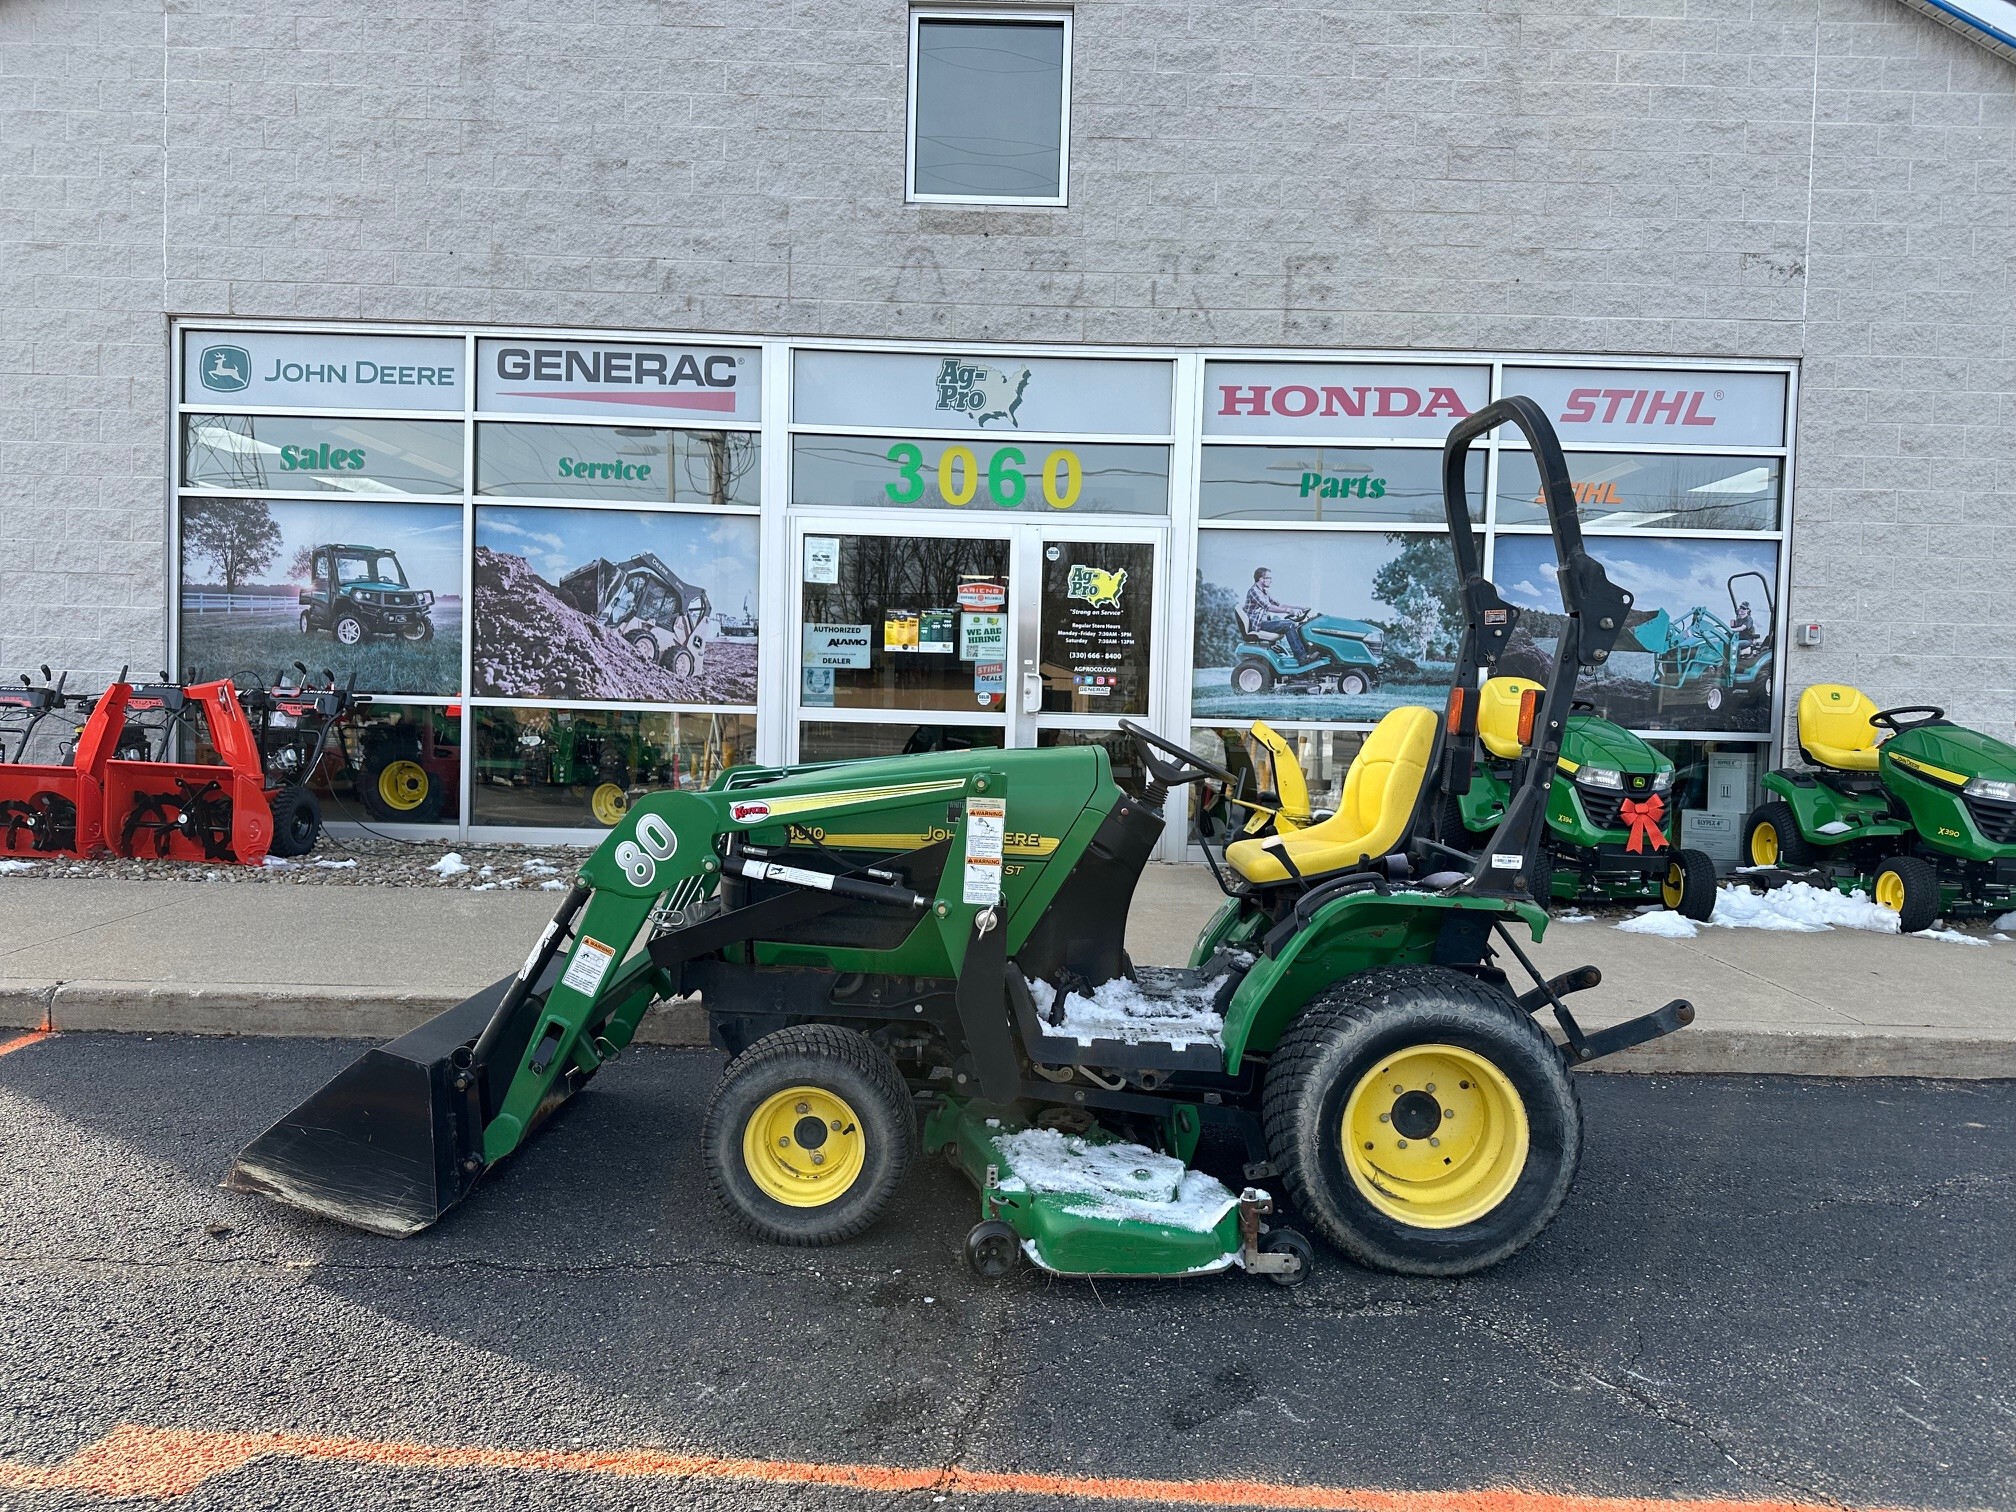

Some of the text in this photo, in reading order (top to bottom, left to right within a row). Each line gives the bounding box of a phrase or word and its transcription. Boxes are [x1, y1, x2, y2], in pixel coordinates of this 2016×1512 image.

[265, 359, 455, 386] JOHN DEERE
[1217, 385, 1474, 418] HONDA
[279, 443, 366, 471] Sales
[558, 456, 651, 481] Service
[885, 442, 1083, 509] 3060
[1299, 472, 1387, 499] Parts
[1534, 481, 1625, 504] SIHL
[813, 626, 861, 634] AUTHORIZED
[968, 635, 1001, 644] HIRING
[983, 627, 1002, 635] ARE
[827, 638, 868, 647] ALAMO
[977, 663, 1002, 674] STIHL
[734, 805, 769, 820] KOYKER
[975, 809, 1003, 817] WARNING
[921, 825, 956, 842] JOH
[1003, 832, 1040, 846] ERE
[1937, 827, 1960, 838] X390
[614, 812, 678, 888] 80
